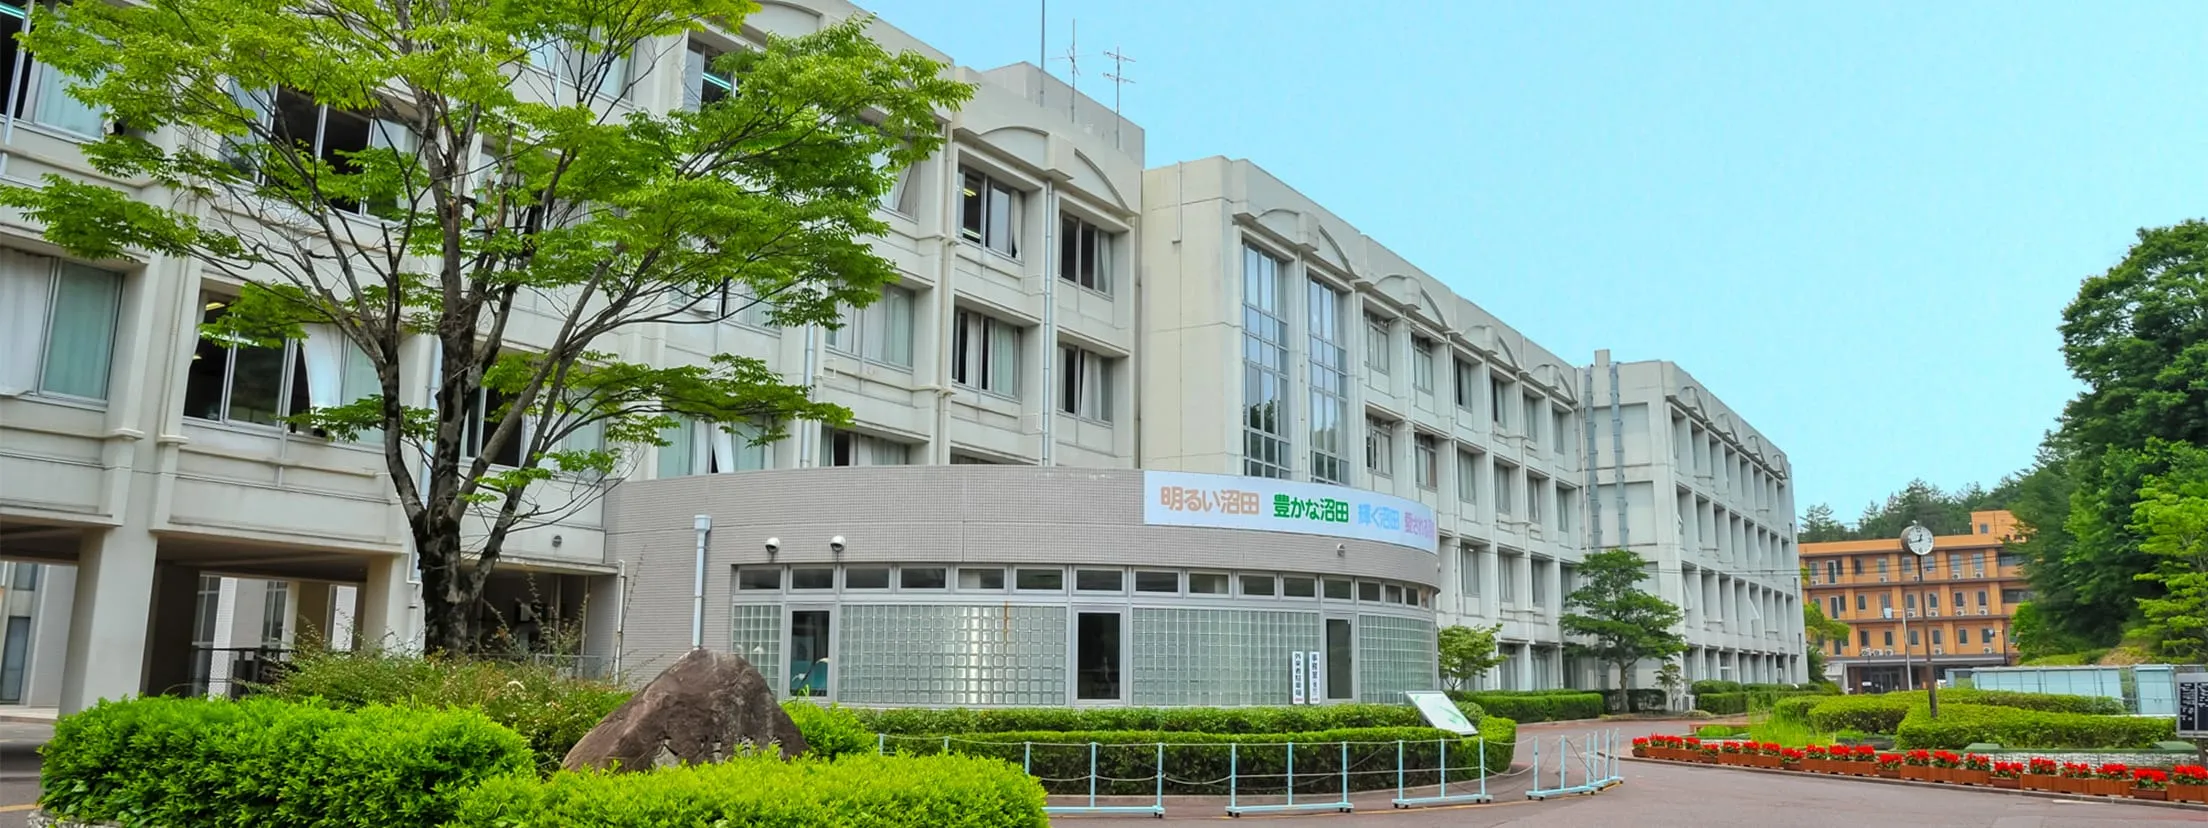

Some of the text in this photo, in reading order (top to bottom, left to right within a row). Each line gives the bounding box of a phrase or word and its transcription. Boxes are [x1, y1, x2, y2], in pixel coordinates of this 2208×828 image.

[1160, 486, 1260, 515] 明るい沼田
[1273, 493, 1349, 523] 豊かな沼田
